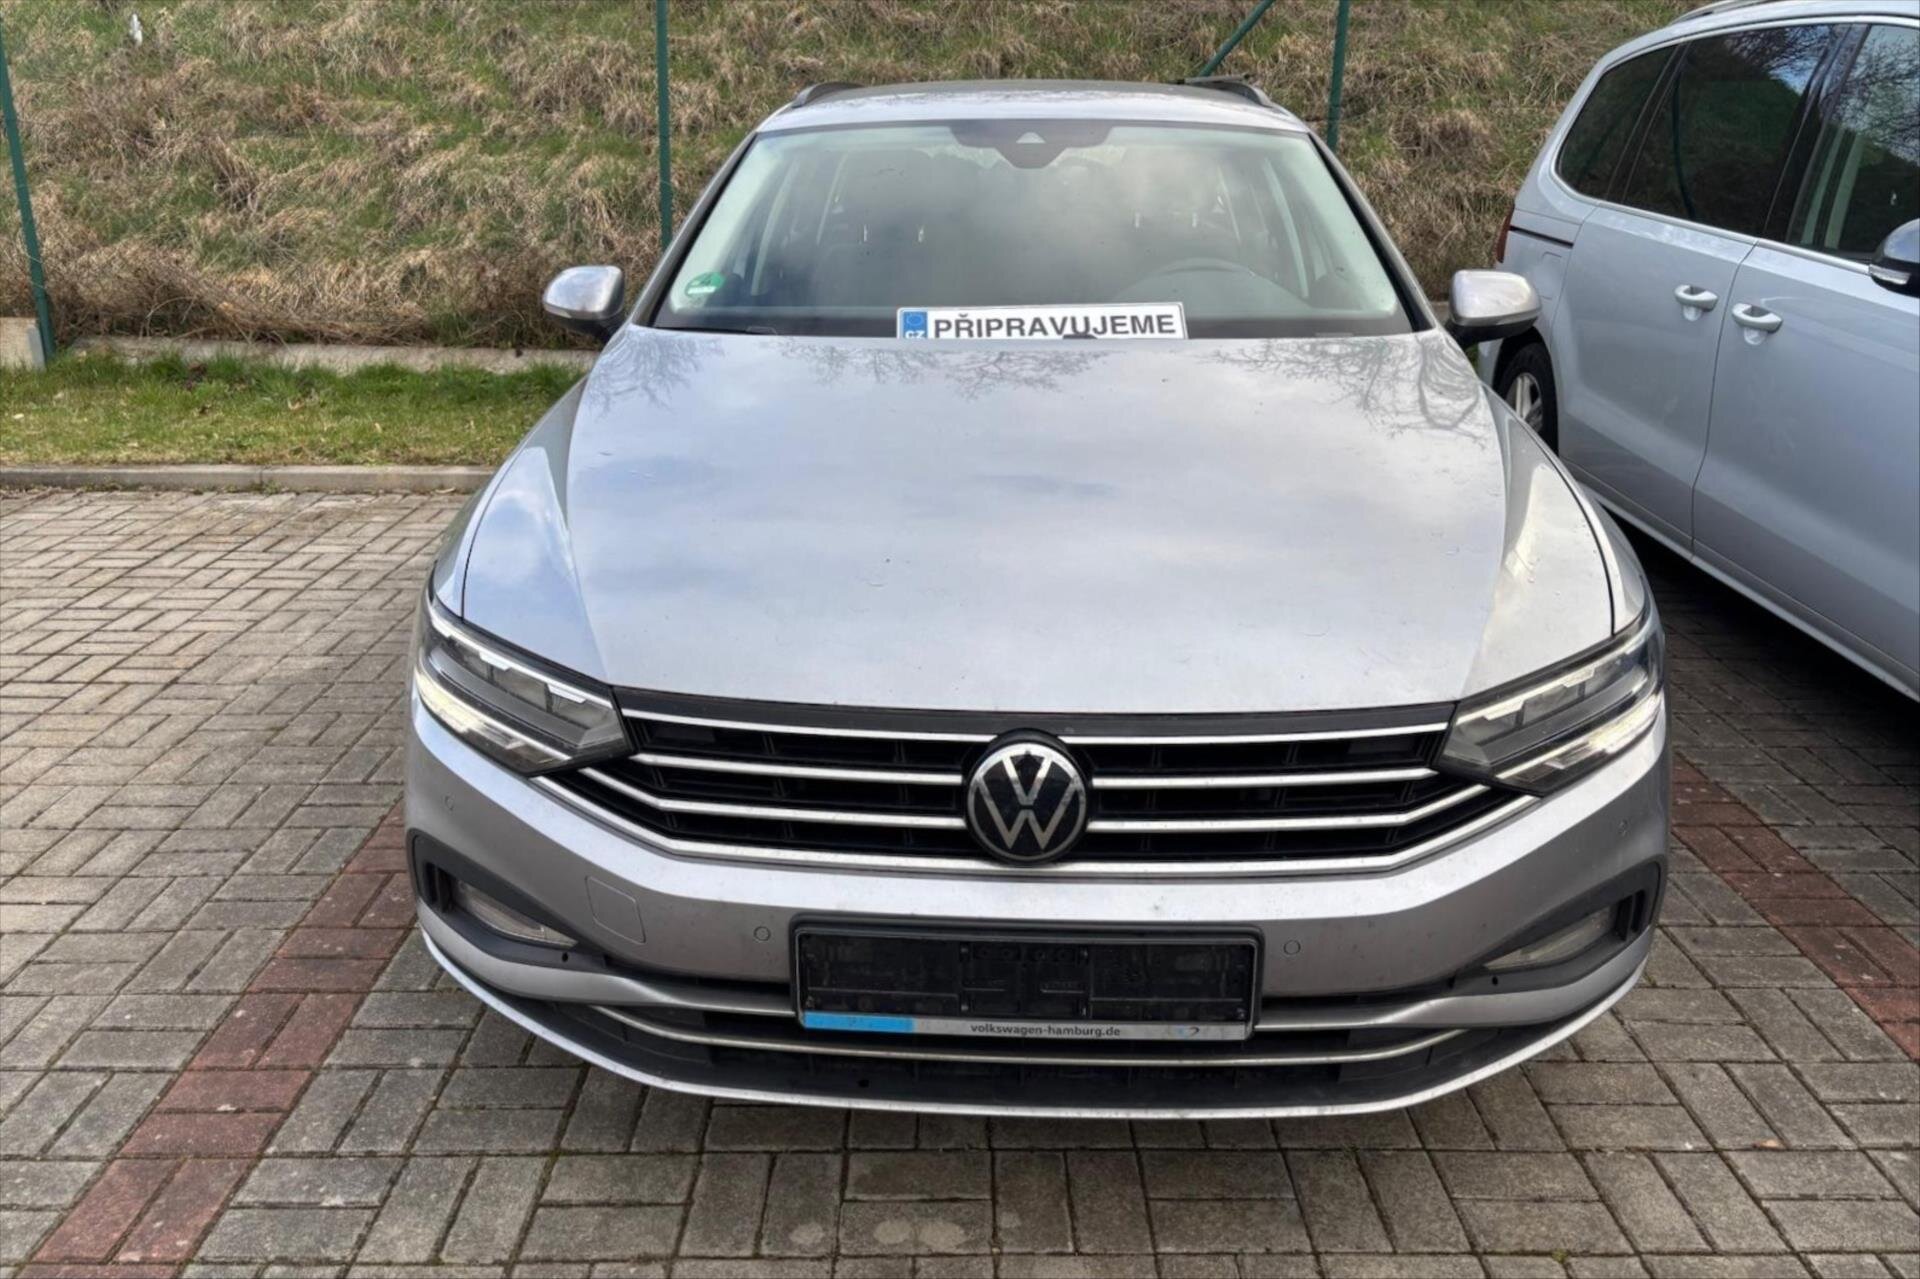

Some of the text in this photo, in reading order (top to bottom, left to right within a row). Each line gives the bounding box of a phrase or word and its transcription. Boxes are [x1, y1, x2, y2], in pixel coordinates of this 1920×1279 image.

[934, 313, 1176, 339] PŘIPRAVUJEME
[974, 750, 1080, 853] VW
[970, 1023, 1121, 1039] volkswagen-hamburg.de
